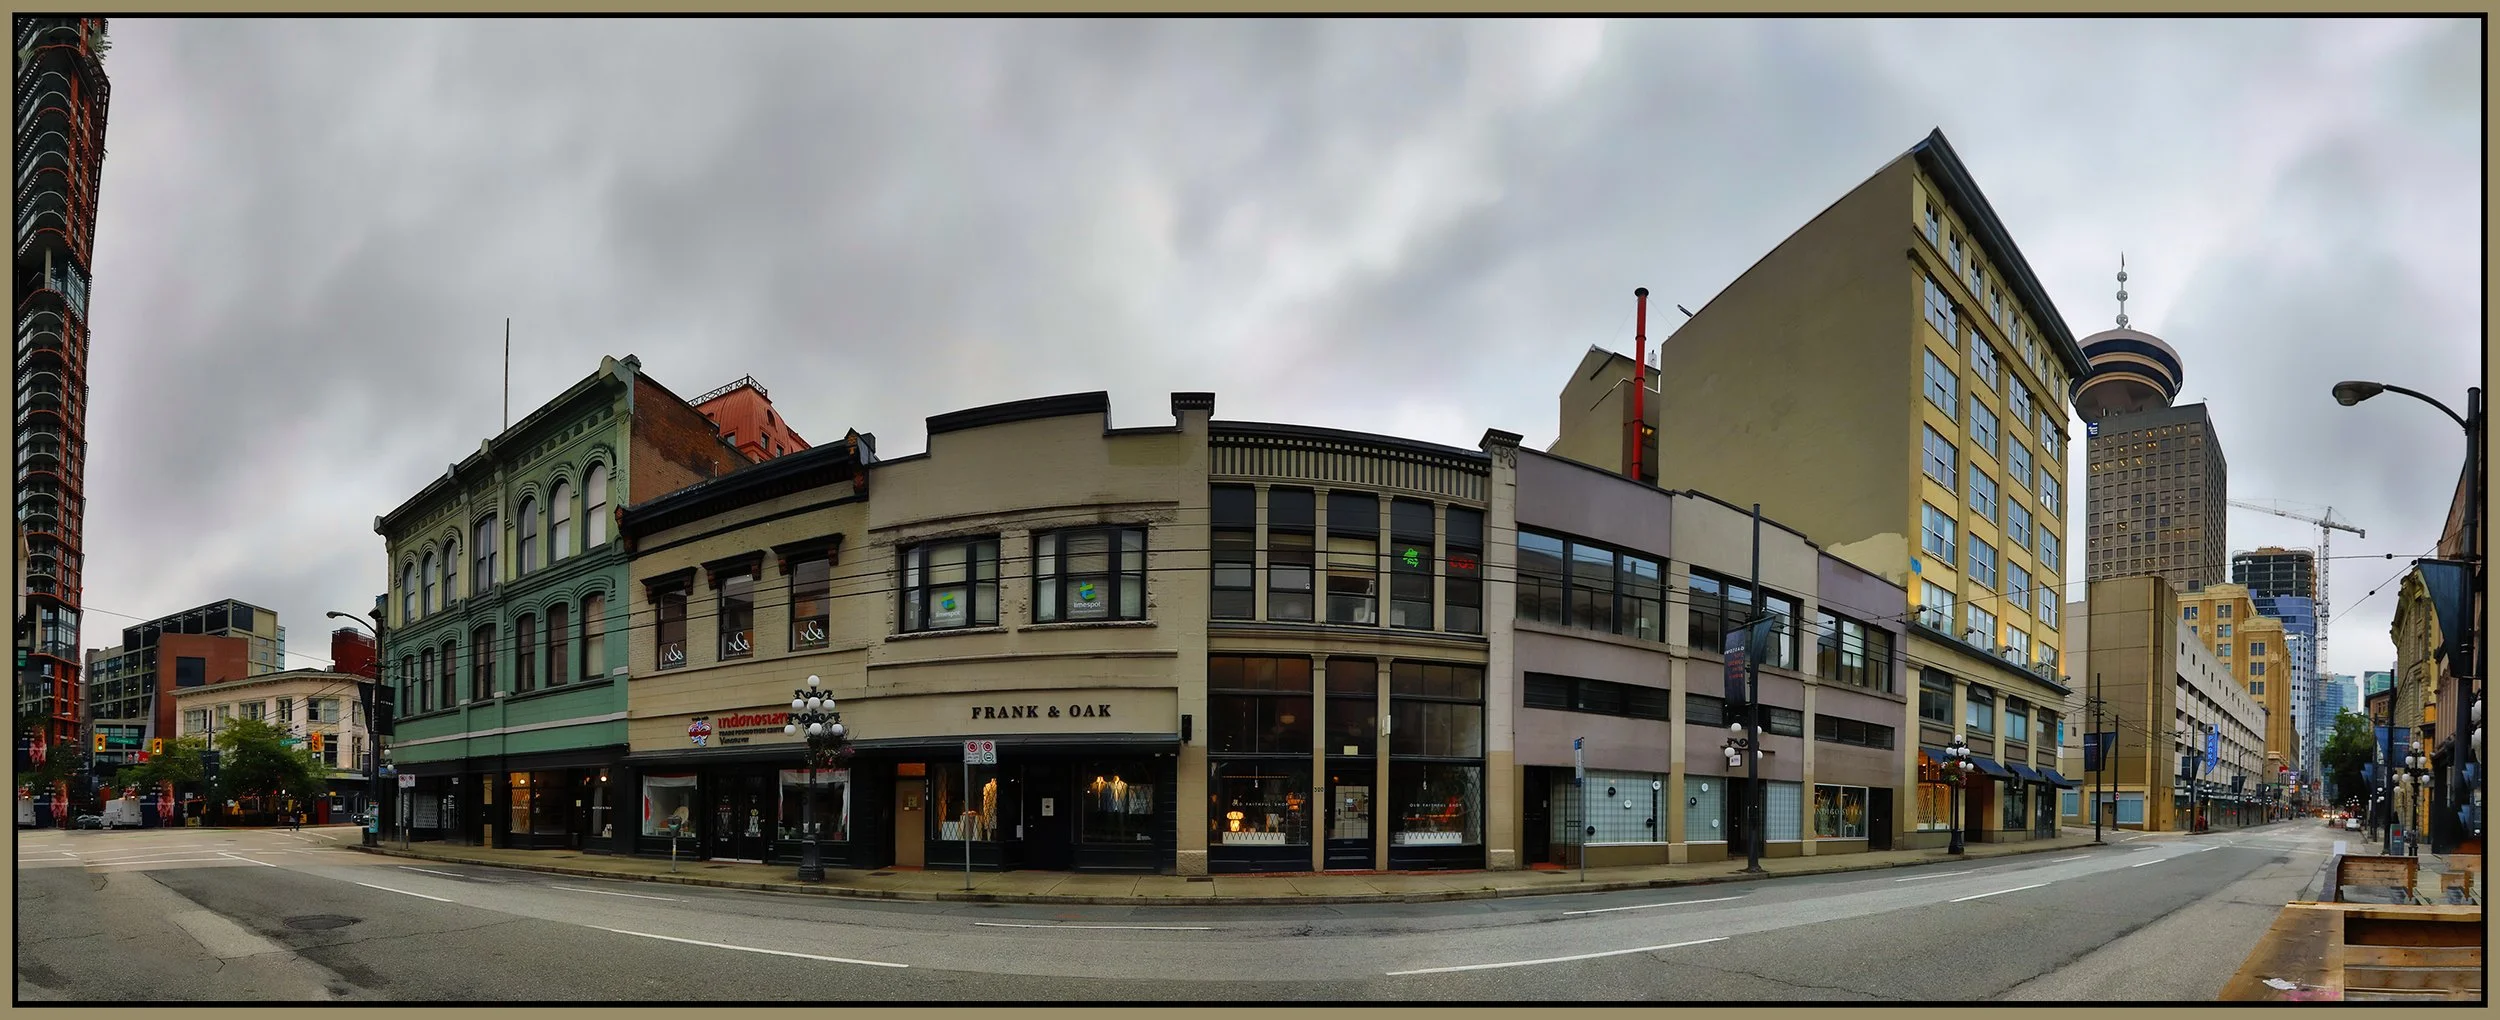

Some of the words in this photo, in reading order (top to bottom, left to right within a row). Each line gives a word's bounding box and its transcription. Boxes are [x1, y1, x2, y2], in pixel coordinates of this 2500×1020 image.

[971, 705, 1039, 719] FRANK
[1047, 705, 1060, 718] &
[1069, 704, 1111, 718] OAK
